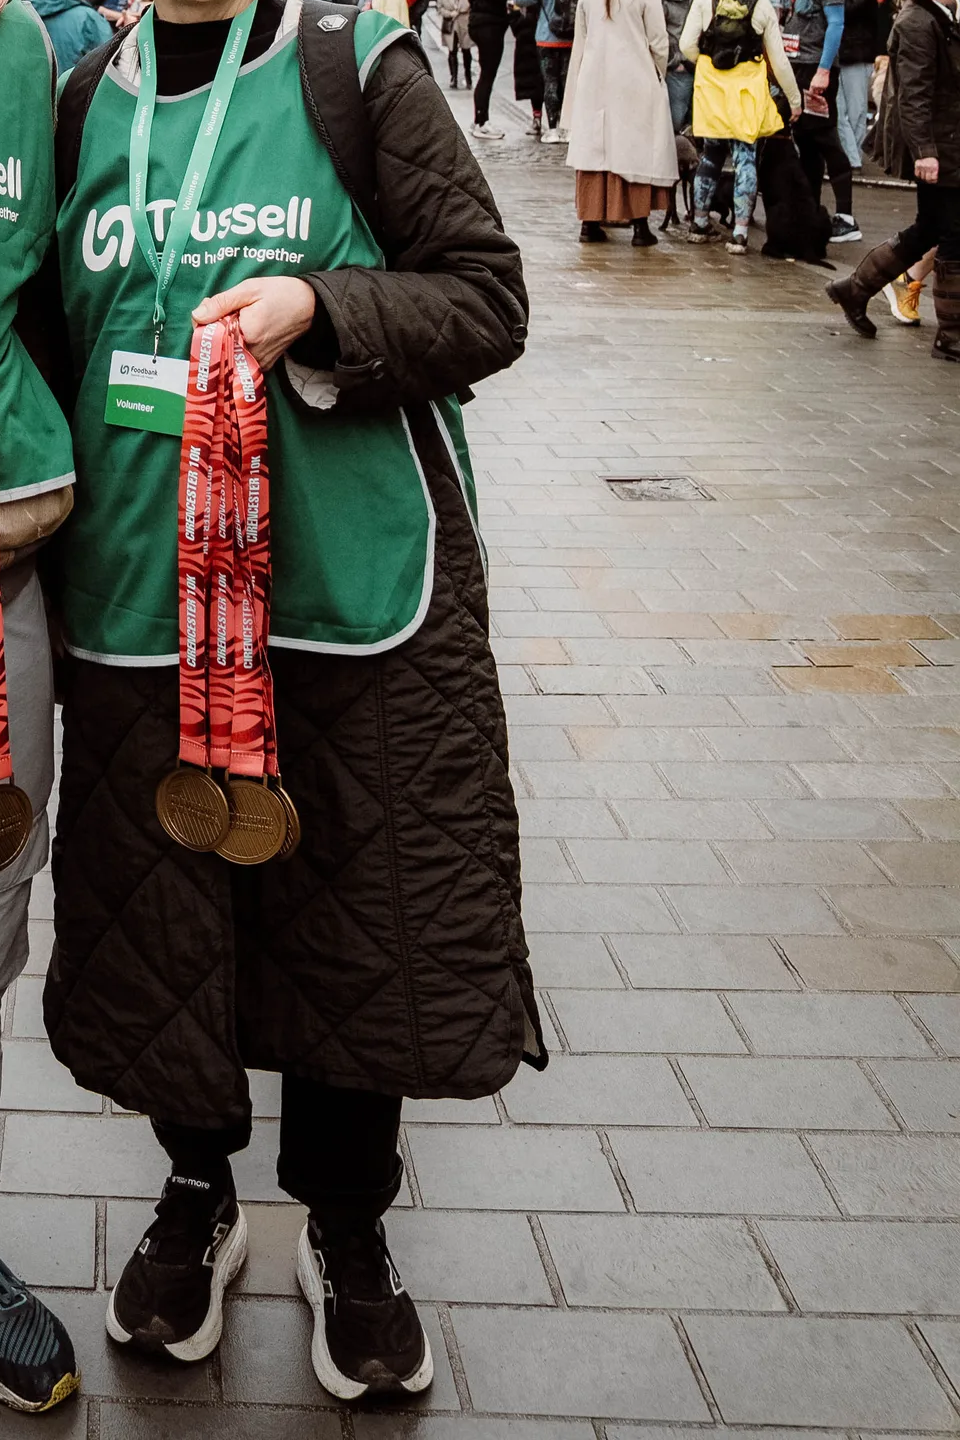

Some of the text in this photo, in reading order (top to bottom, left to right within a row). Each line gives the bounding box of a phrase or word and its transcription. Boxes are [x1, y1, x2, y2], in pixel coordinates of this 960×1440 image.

[227, 27, 244, 65] Volunteer
[205, 98, 222, 137] Volunteer
[182, 171, 200, 211] Volunteer
[145, 196, 312, 242] Tussell
[161, 248, 177, 290] Volunteer
[242, 245, 305, 265] together
[130, 365, 158, 377] Foodbank
[116, 398, 155, 414] Volunteer
[185, 445, 201, 542] CIRENCESTER 10K
[247, 455, 261, 543] CIRENCESTER 10K
[186, 572, 197, 668] CIRENCESTER 10K
[217, 572, 227, 667] CIRENCESTER 10K
[188, 1178, 210, 1190] more
